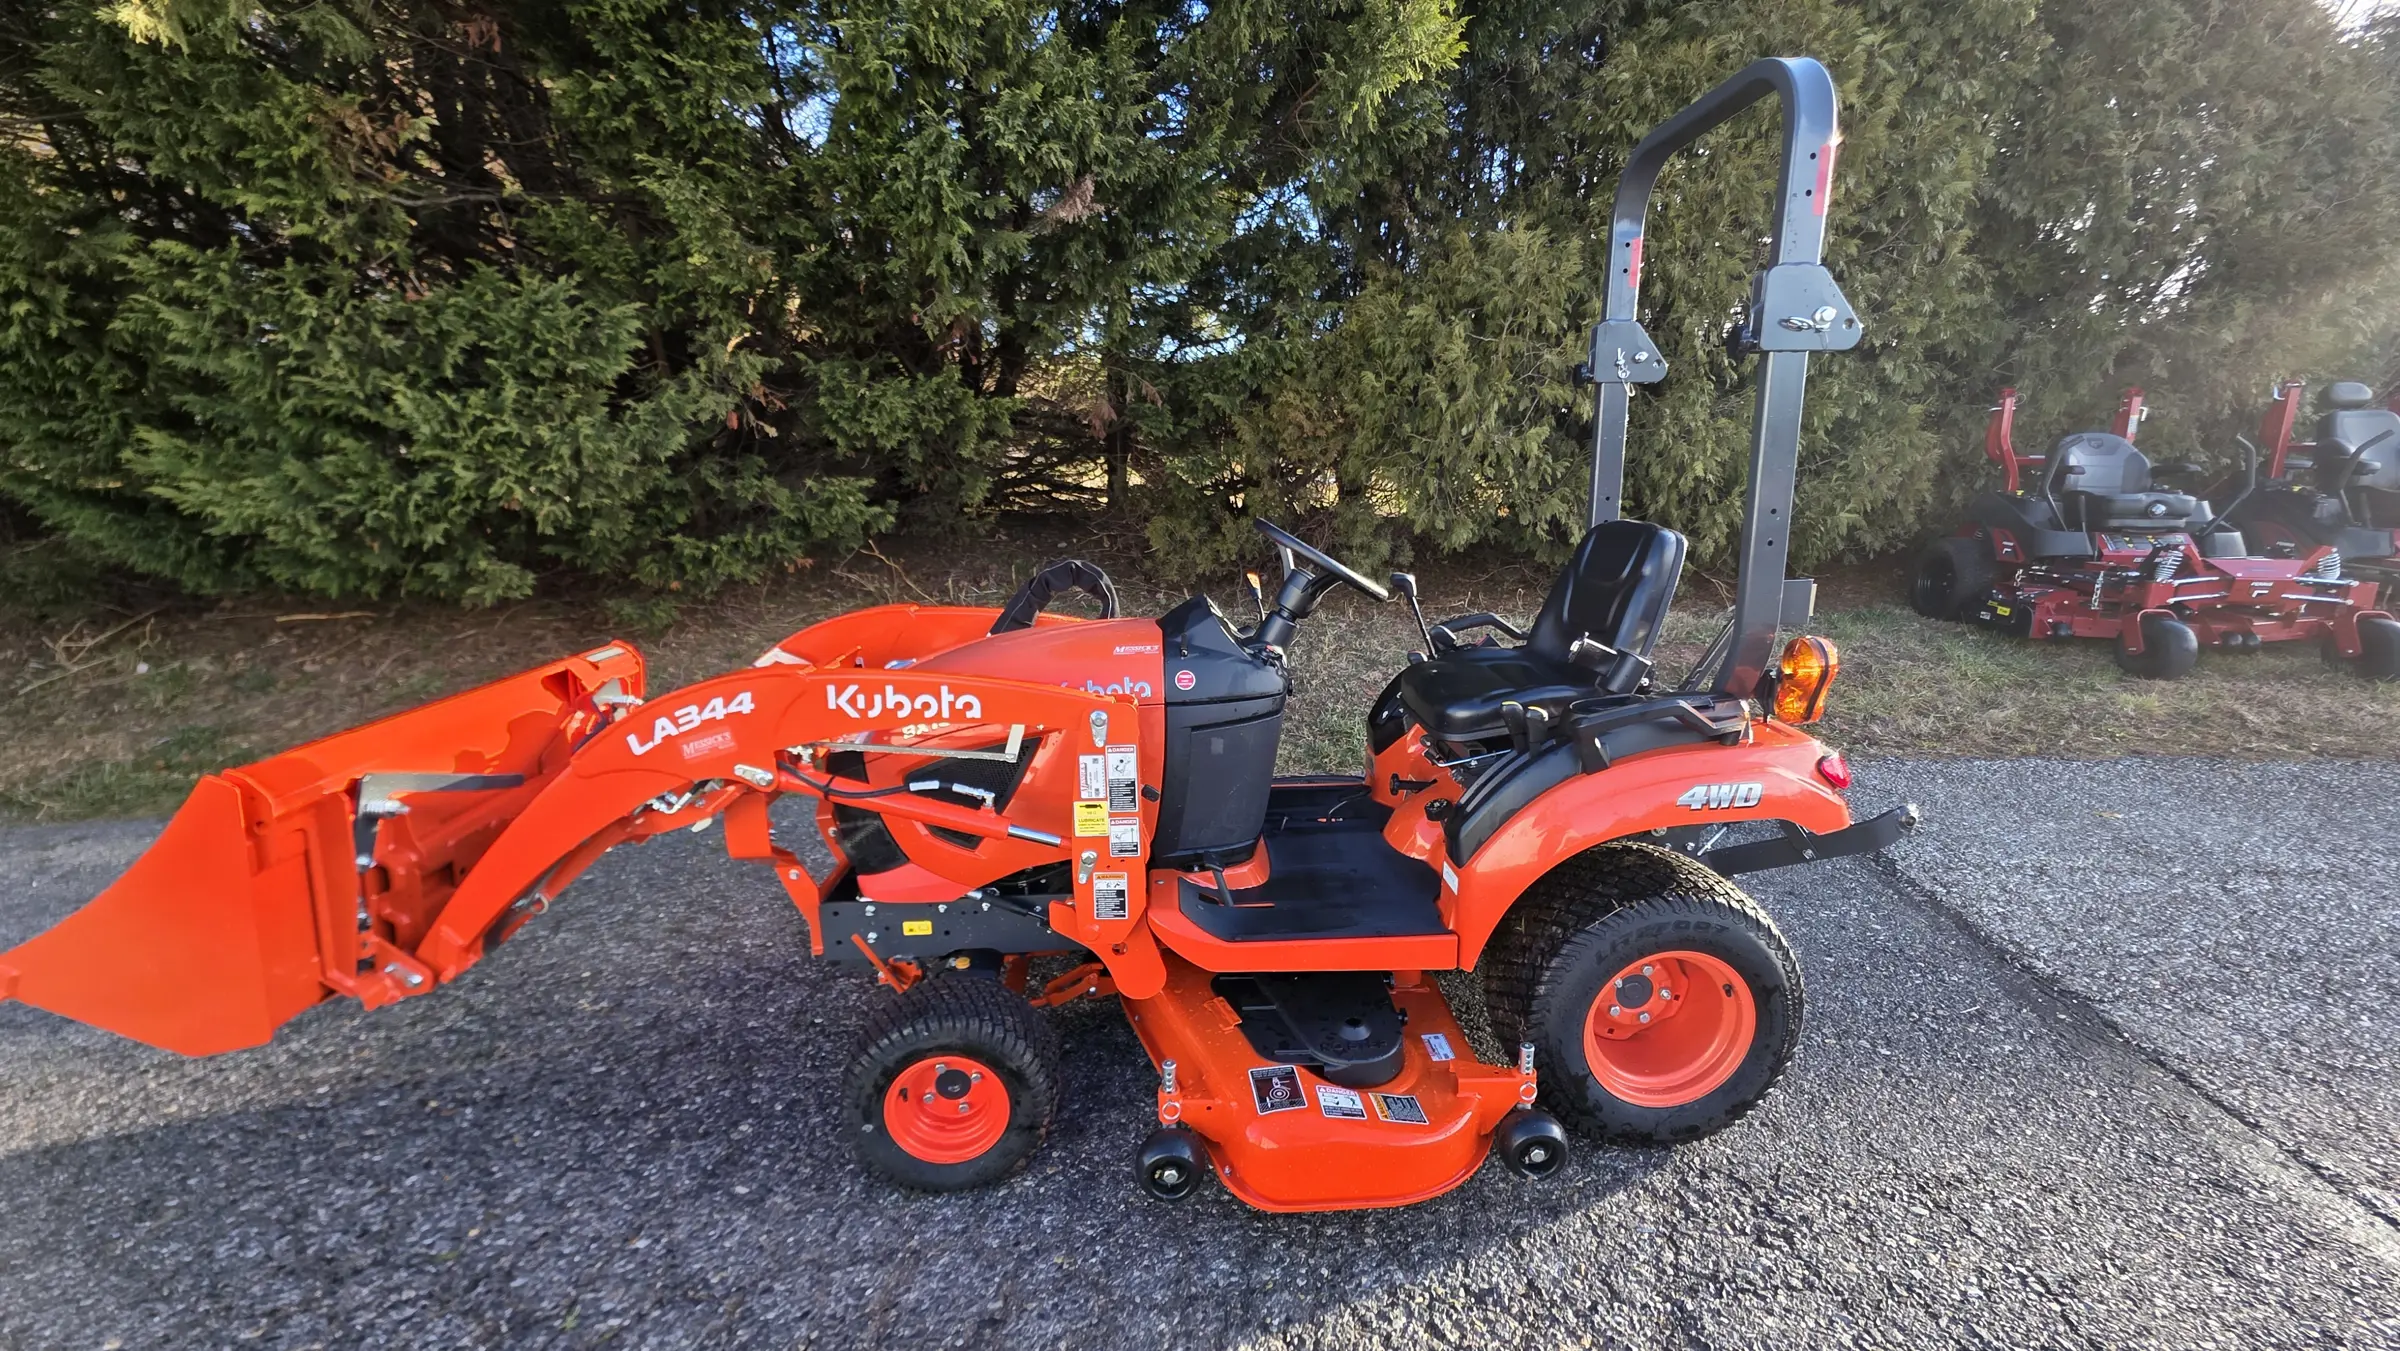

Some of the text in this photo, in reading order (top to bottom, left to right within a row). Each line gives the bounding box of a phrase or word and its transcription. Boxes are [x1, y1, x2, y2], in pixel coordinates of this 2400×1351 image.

[826, 684, 982, 719] Kubota
[626, 691, 756, 756] LA344
[681, 730, 733, 758] MESSICK'S
[1675, 781, 1764, 811] 4WD
[1326, 1087, 1357, 1097] DANGER
